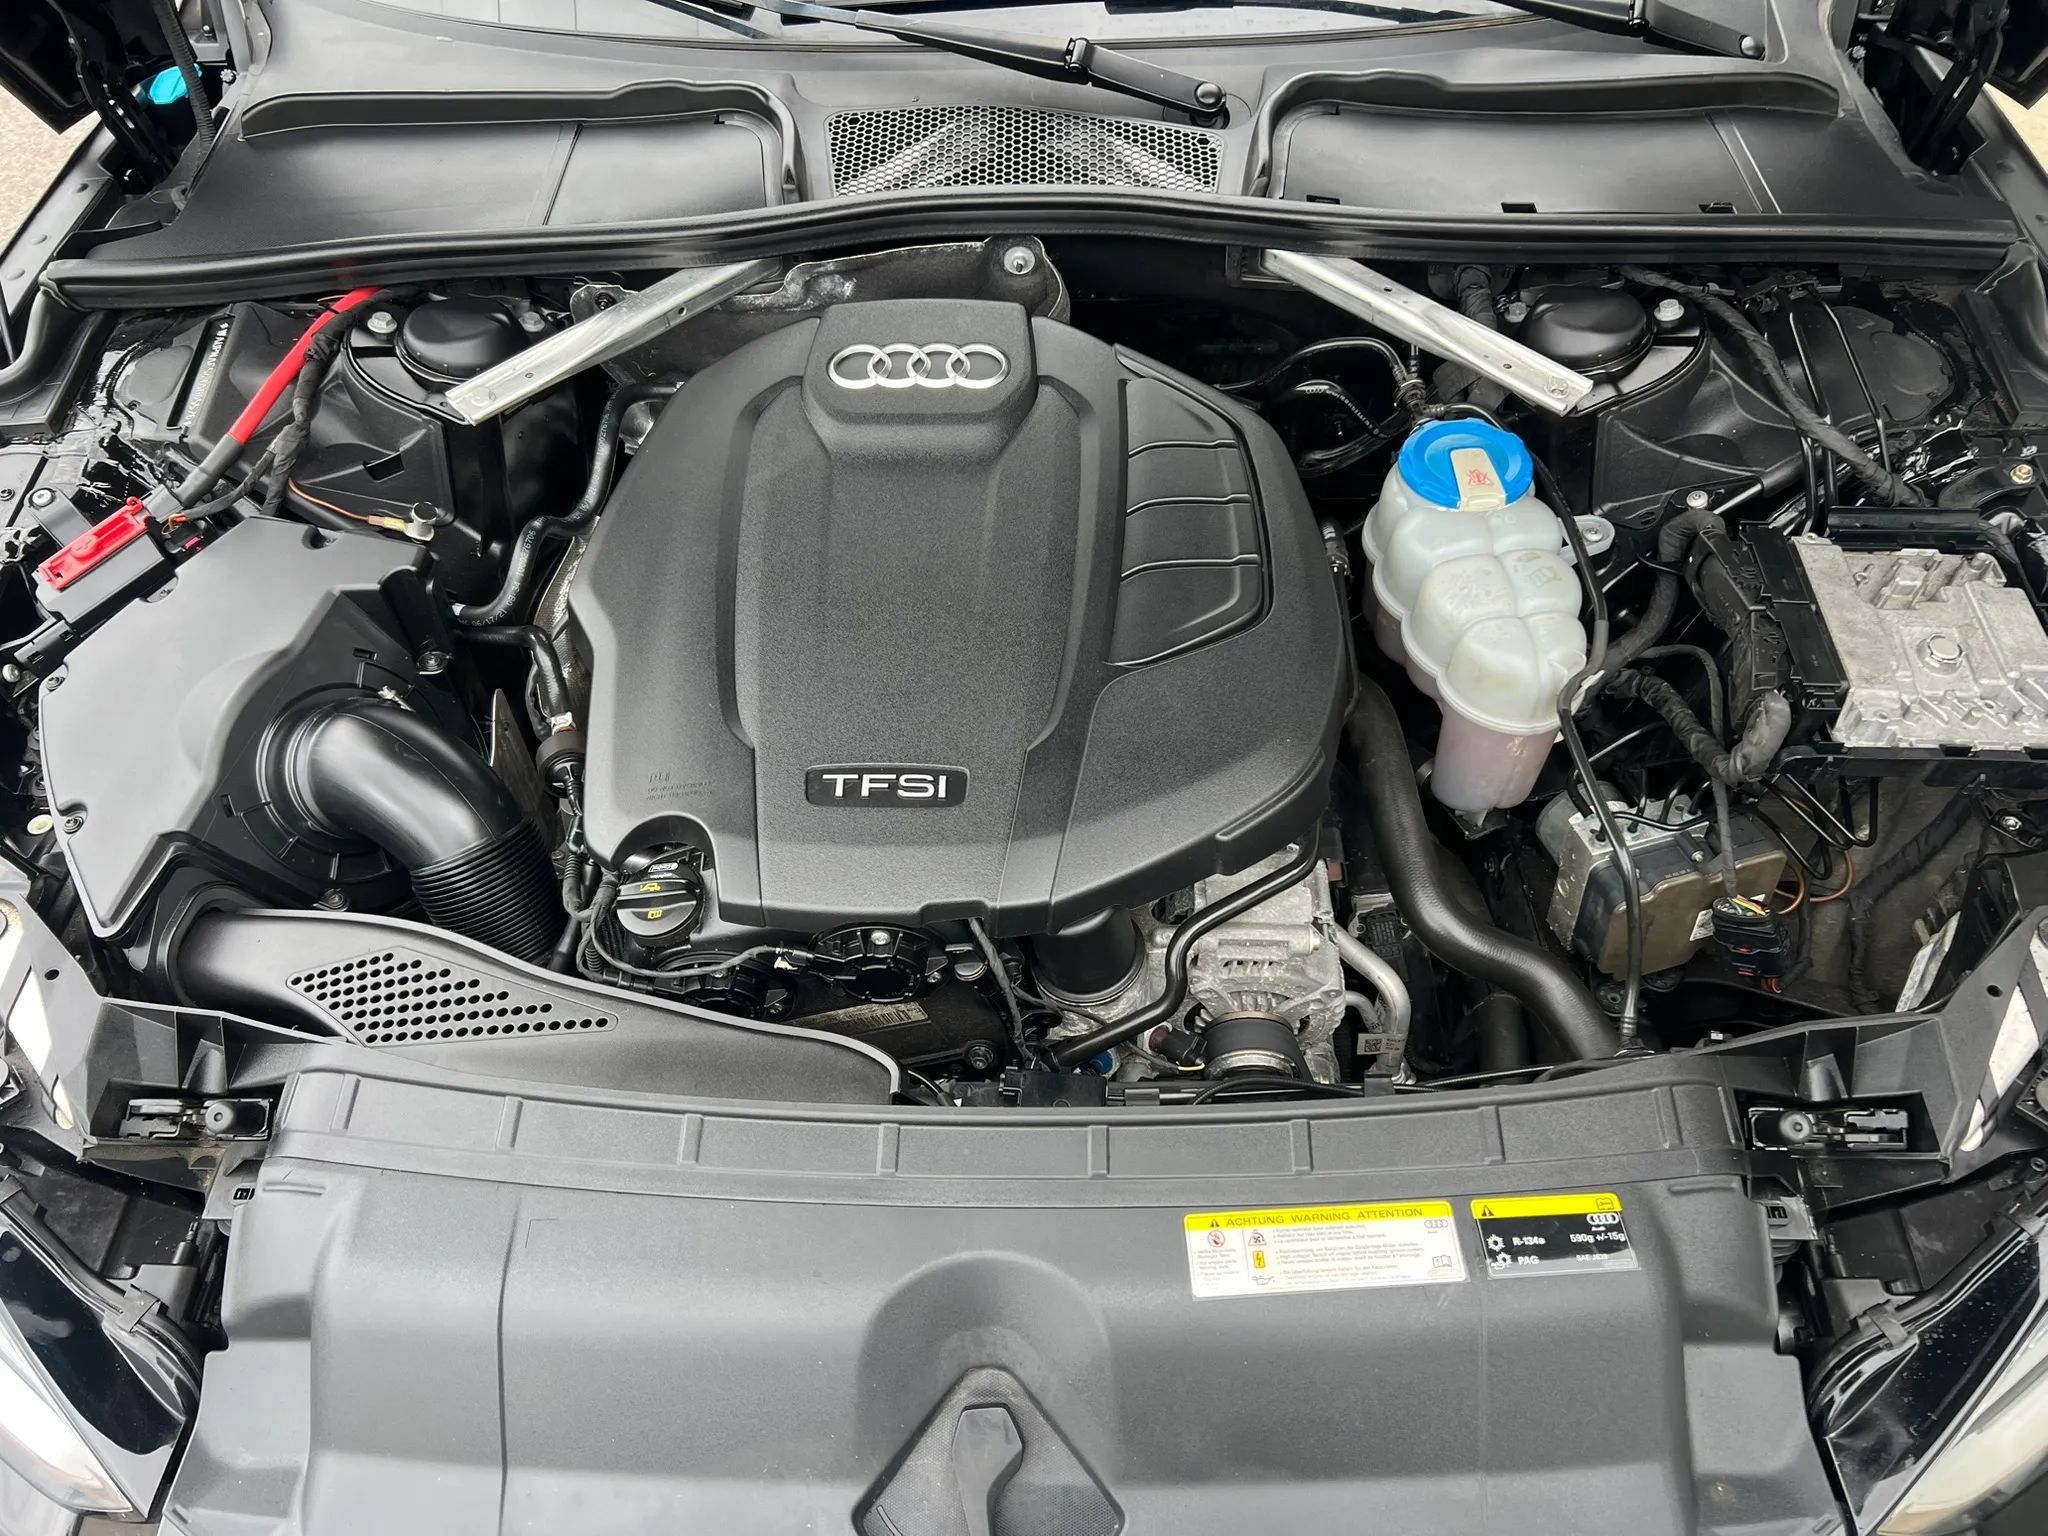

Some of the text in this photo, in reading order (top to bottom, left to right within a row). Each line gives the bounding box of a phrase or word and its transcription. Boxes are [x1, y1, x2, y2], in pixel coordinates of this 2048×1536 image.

[822, 773, 948, 800] TFSI
[1226, 1214, 1285, 1228] ACHTUNG
[1291, 1210, 1351, 1224] WARNING
[1357, 1207, 1424, 1221] ATTENTION
[1511, 1231, 1626, 1247] R-134a 590g +/-15g
[1517, 1255, 1540, 1265] PAG
